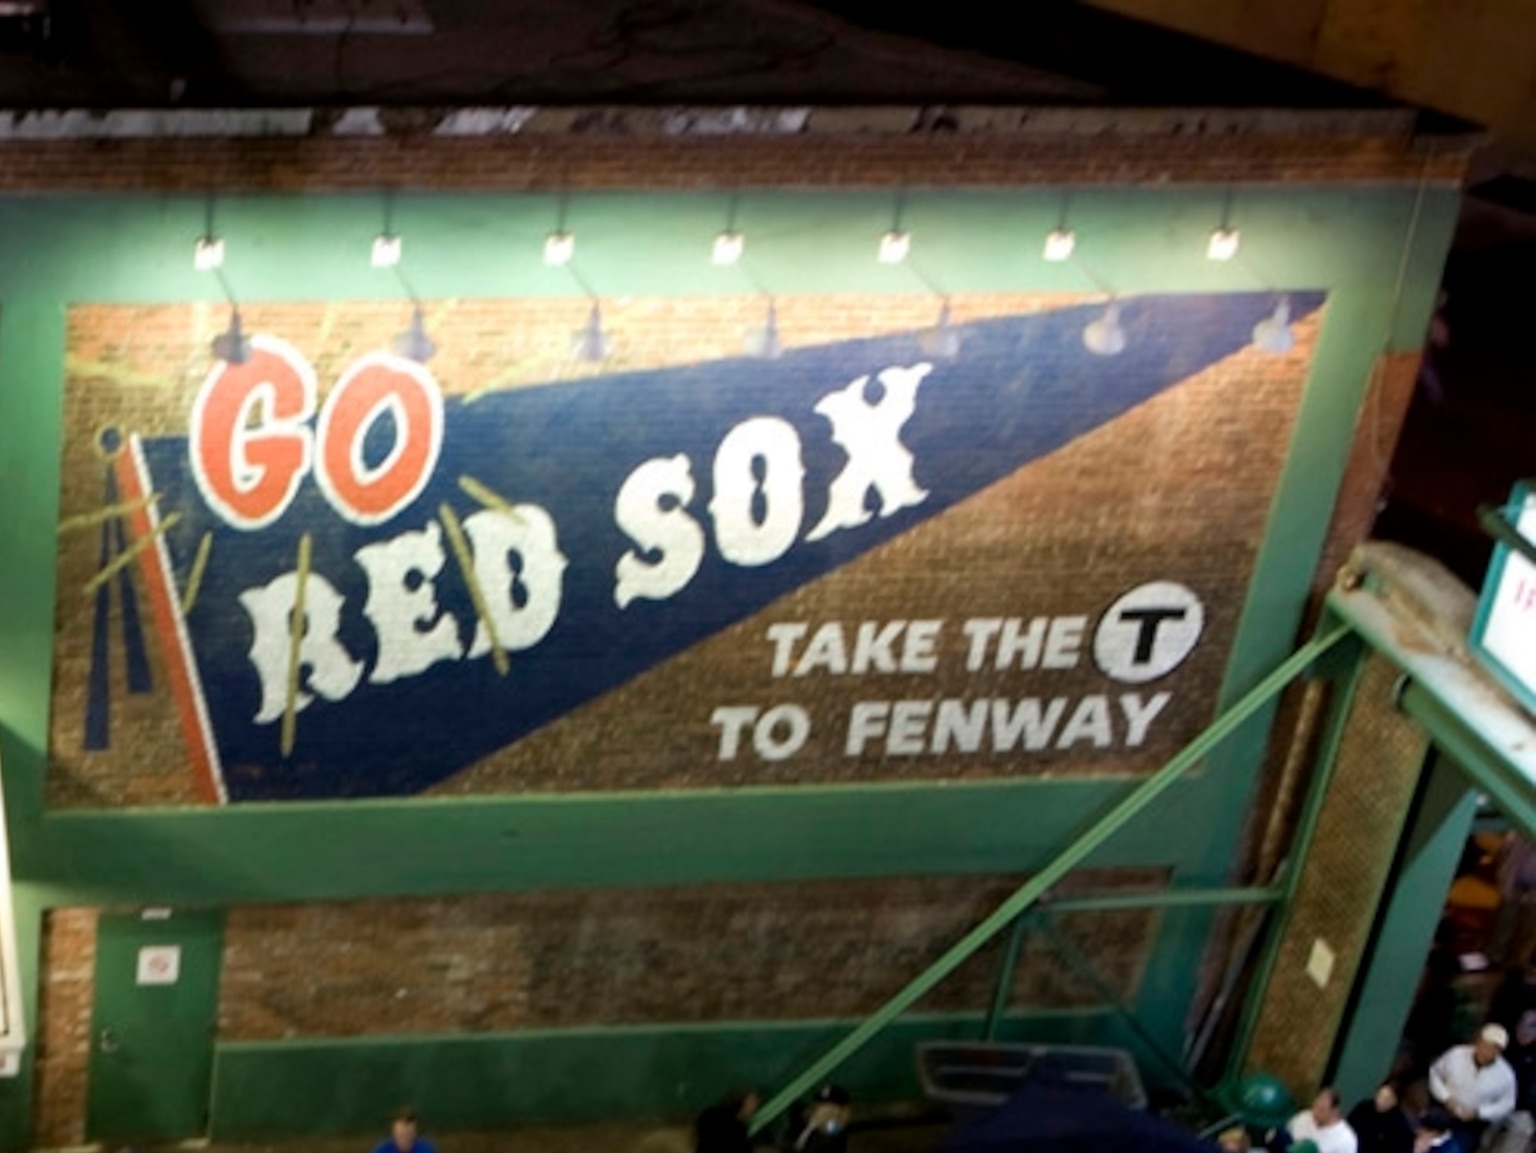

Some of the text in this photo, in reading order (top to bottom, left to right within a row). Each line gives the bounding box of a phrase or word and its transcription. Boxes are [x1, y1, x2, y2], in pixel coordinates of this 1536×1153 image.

[189, 334, 444, 529] GO
[238, 361, 935, 725] RED SOX
[765, 617, 946, 678] TAKE
[964, 615, 1087, 671] THE
[710, 692, 1173, 761] TO FENWAY
